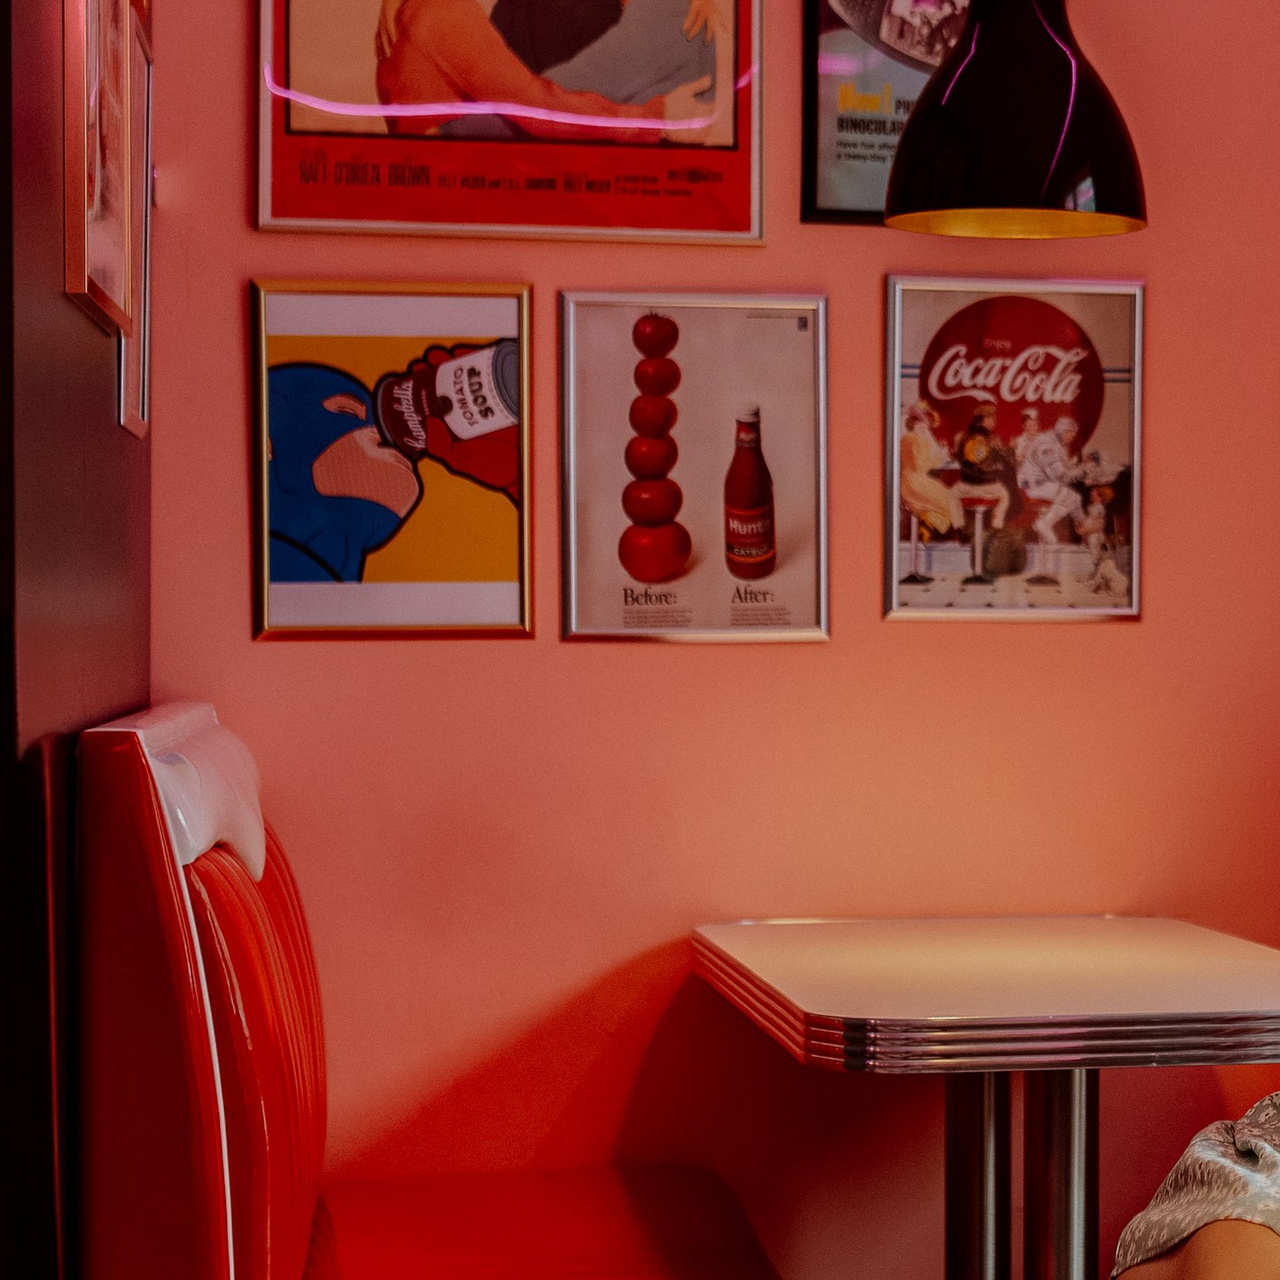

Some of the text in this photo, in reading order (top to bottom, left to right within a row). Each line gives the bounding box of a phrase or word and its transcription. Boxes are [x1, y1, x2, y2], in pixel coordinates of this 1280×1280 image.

[453, 367, 478, 427] TOMATO
[467, 367, 495, 419] SOUP
[927, 343, 1090, 405] Coca-Cola
[622, 586, 678, 606] Before:
[731, 585, 774, 604] After:
